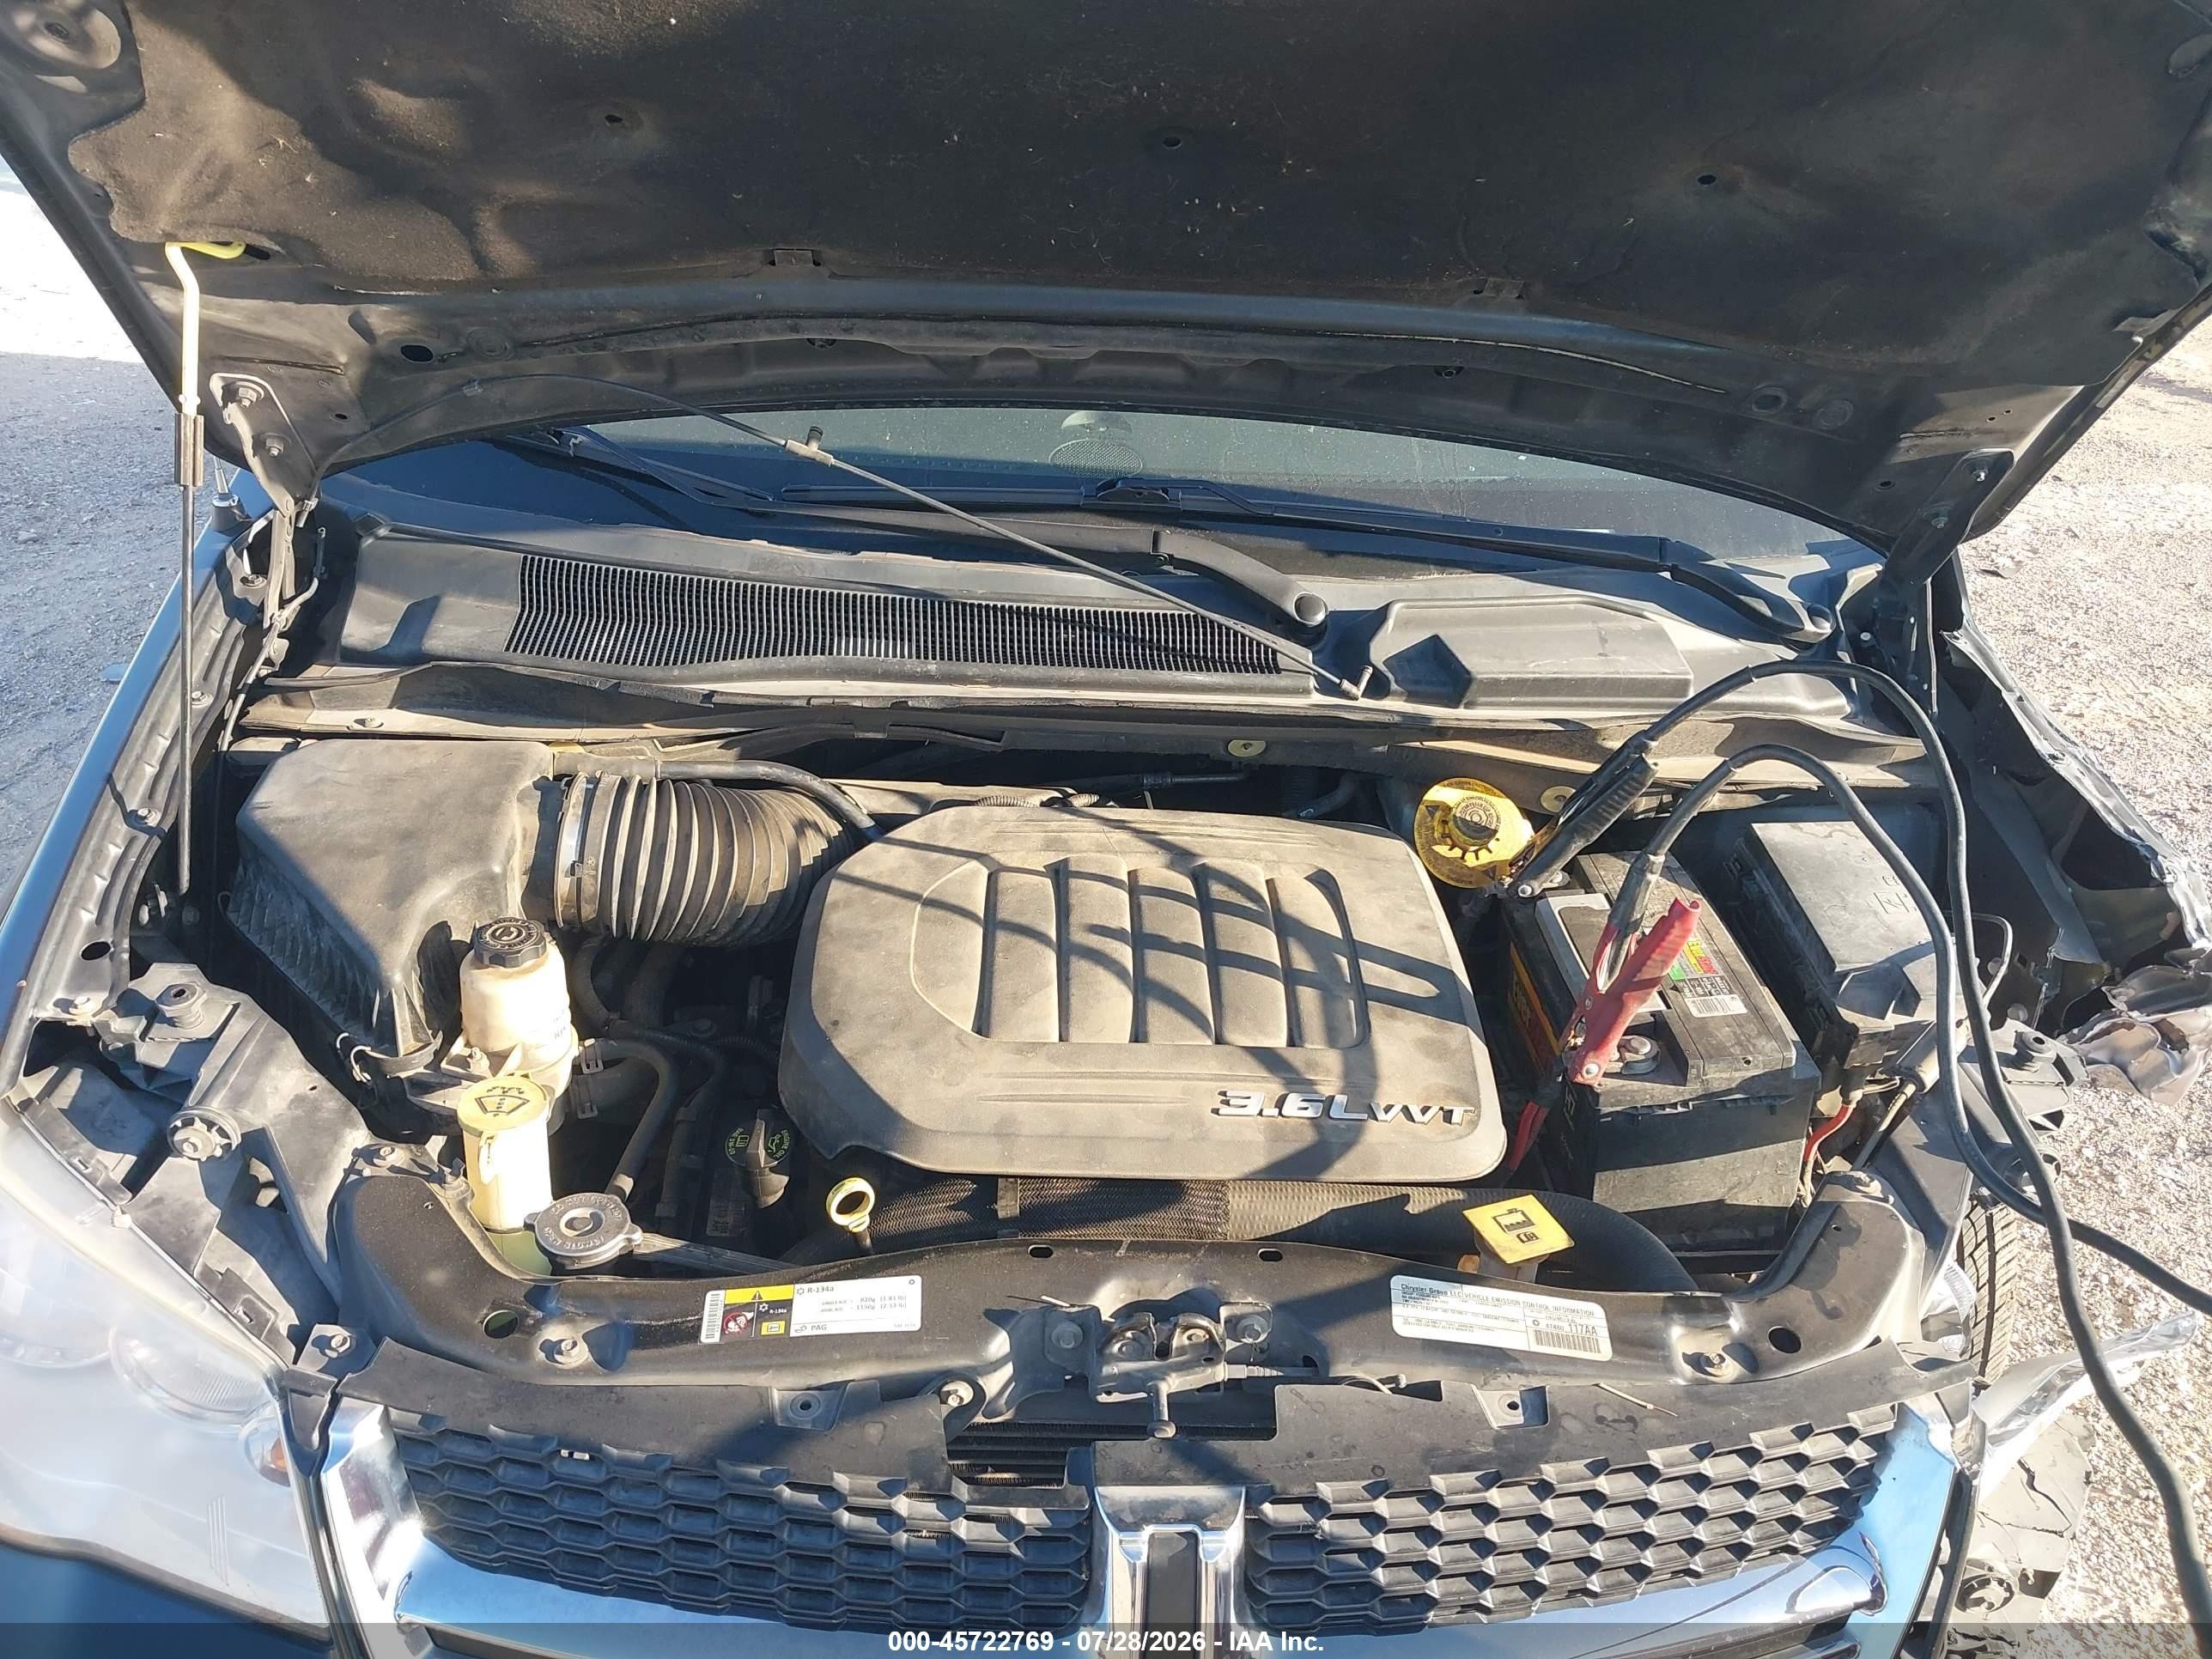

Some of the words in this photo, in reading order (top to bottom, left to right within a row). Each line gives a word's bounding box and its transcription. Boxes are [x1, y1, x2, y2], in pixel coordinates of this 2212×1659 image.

[1211, 1090, 1368, 1121] 3.6L
[1369, 1102, 1476, 1127] VVT
[781, 1129, 790, 1150] ENGINE
[774, 1149, 785, 1158] OIL
[807, 1285, 835, 1294] R-134a
[1401, 1283, 1426, 1292] Chrysler
[1429, 1287, 1448, 1296] Group
[1464, 1291, 1489, 1301] VEHICLE
[1492, 1295, 1521, 1306] EMISSION
[1522, 1301, 1551, 1311] CONTROL
[1552, 1304, 1595, 1317] INFORMATION
[811, 1323, 828, 1332] PAG
